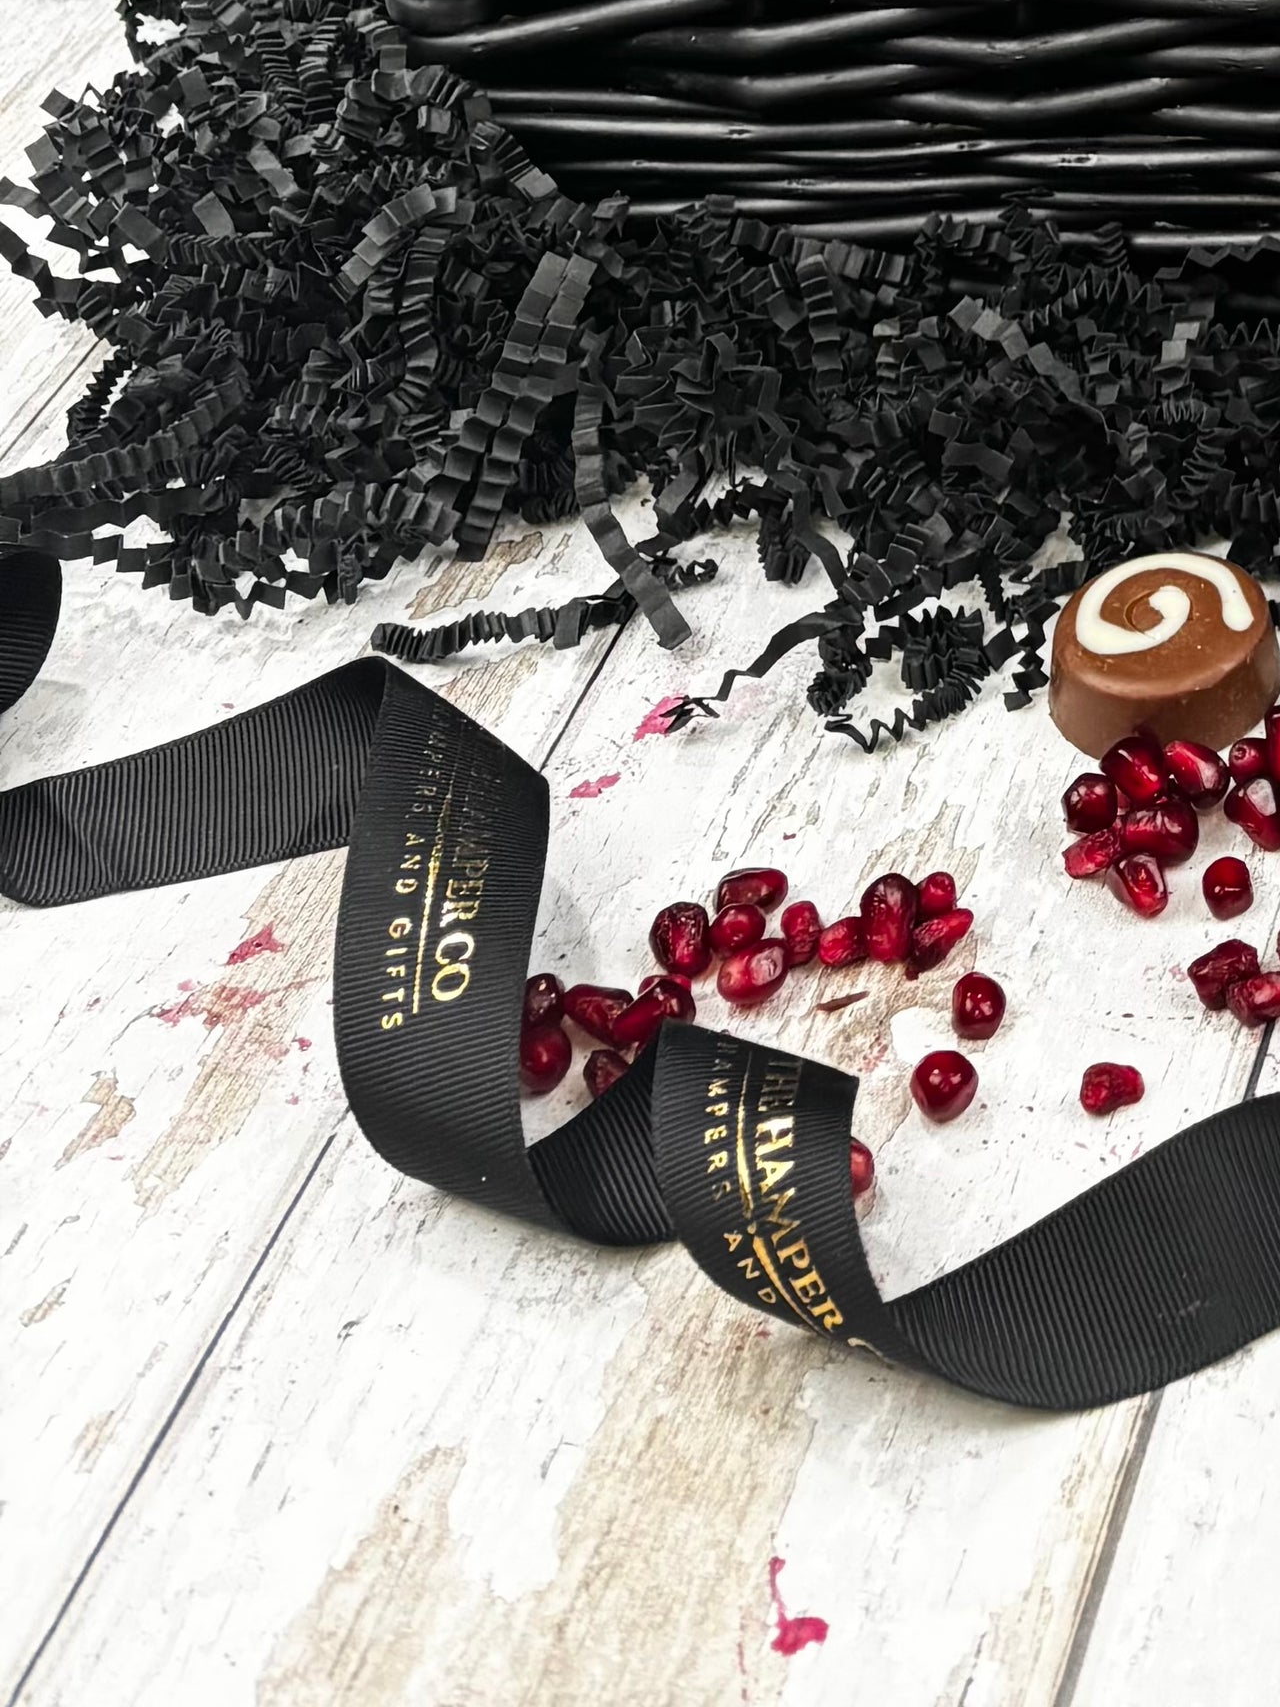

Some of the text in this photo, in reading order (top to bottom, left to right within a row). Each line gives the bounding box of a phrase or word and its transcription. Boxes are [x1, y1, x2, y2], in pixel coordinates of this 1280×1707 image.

[395, 833, 425, 894] AND
[381, 917, 413, 1030] GIFTS
[431, 931, 475, 1002] CO
[754, 1058, 844, 1333] THE HAMPER
[723, 1231, 777, 1304] AND
